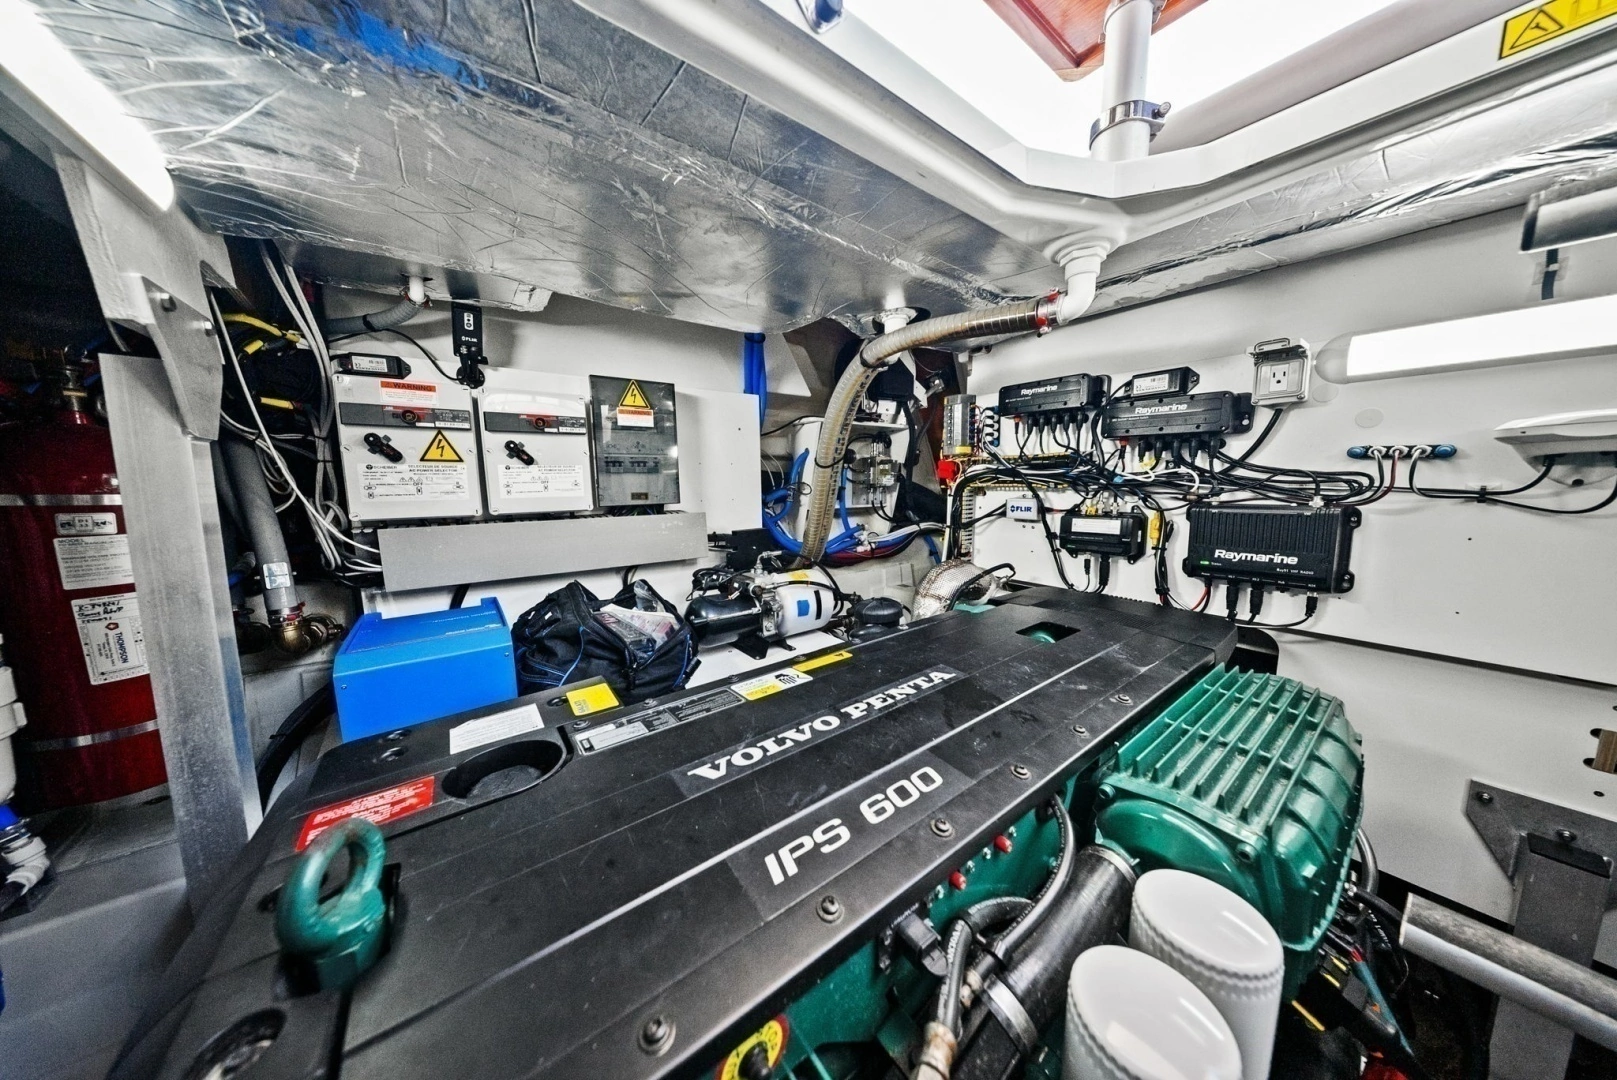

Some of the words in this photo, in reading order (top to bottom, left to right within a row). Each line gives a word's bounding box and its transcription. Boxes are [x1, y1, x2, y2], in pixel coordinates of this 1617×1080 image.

[393, 381, 432, 392] WARNING
[1020, 384, 1058, 396] Raymarine
[1135, 403, 1188, 416] Raymarine
[1015, 505, 1033, 513] FLIR
[1214, 549, 1298, 565] Raymarine
[114, 632, 129, 664] THOMPSON
[687, 715, 841, 780] VOLVO
[840, 670, 956, 720] PENTA
[764, 818, 851, 886] IPS
[859, 766, 943, 825] 600
